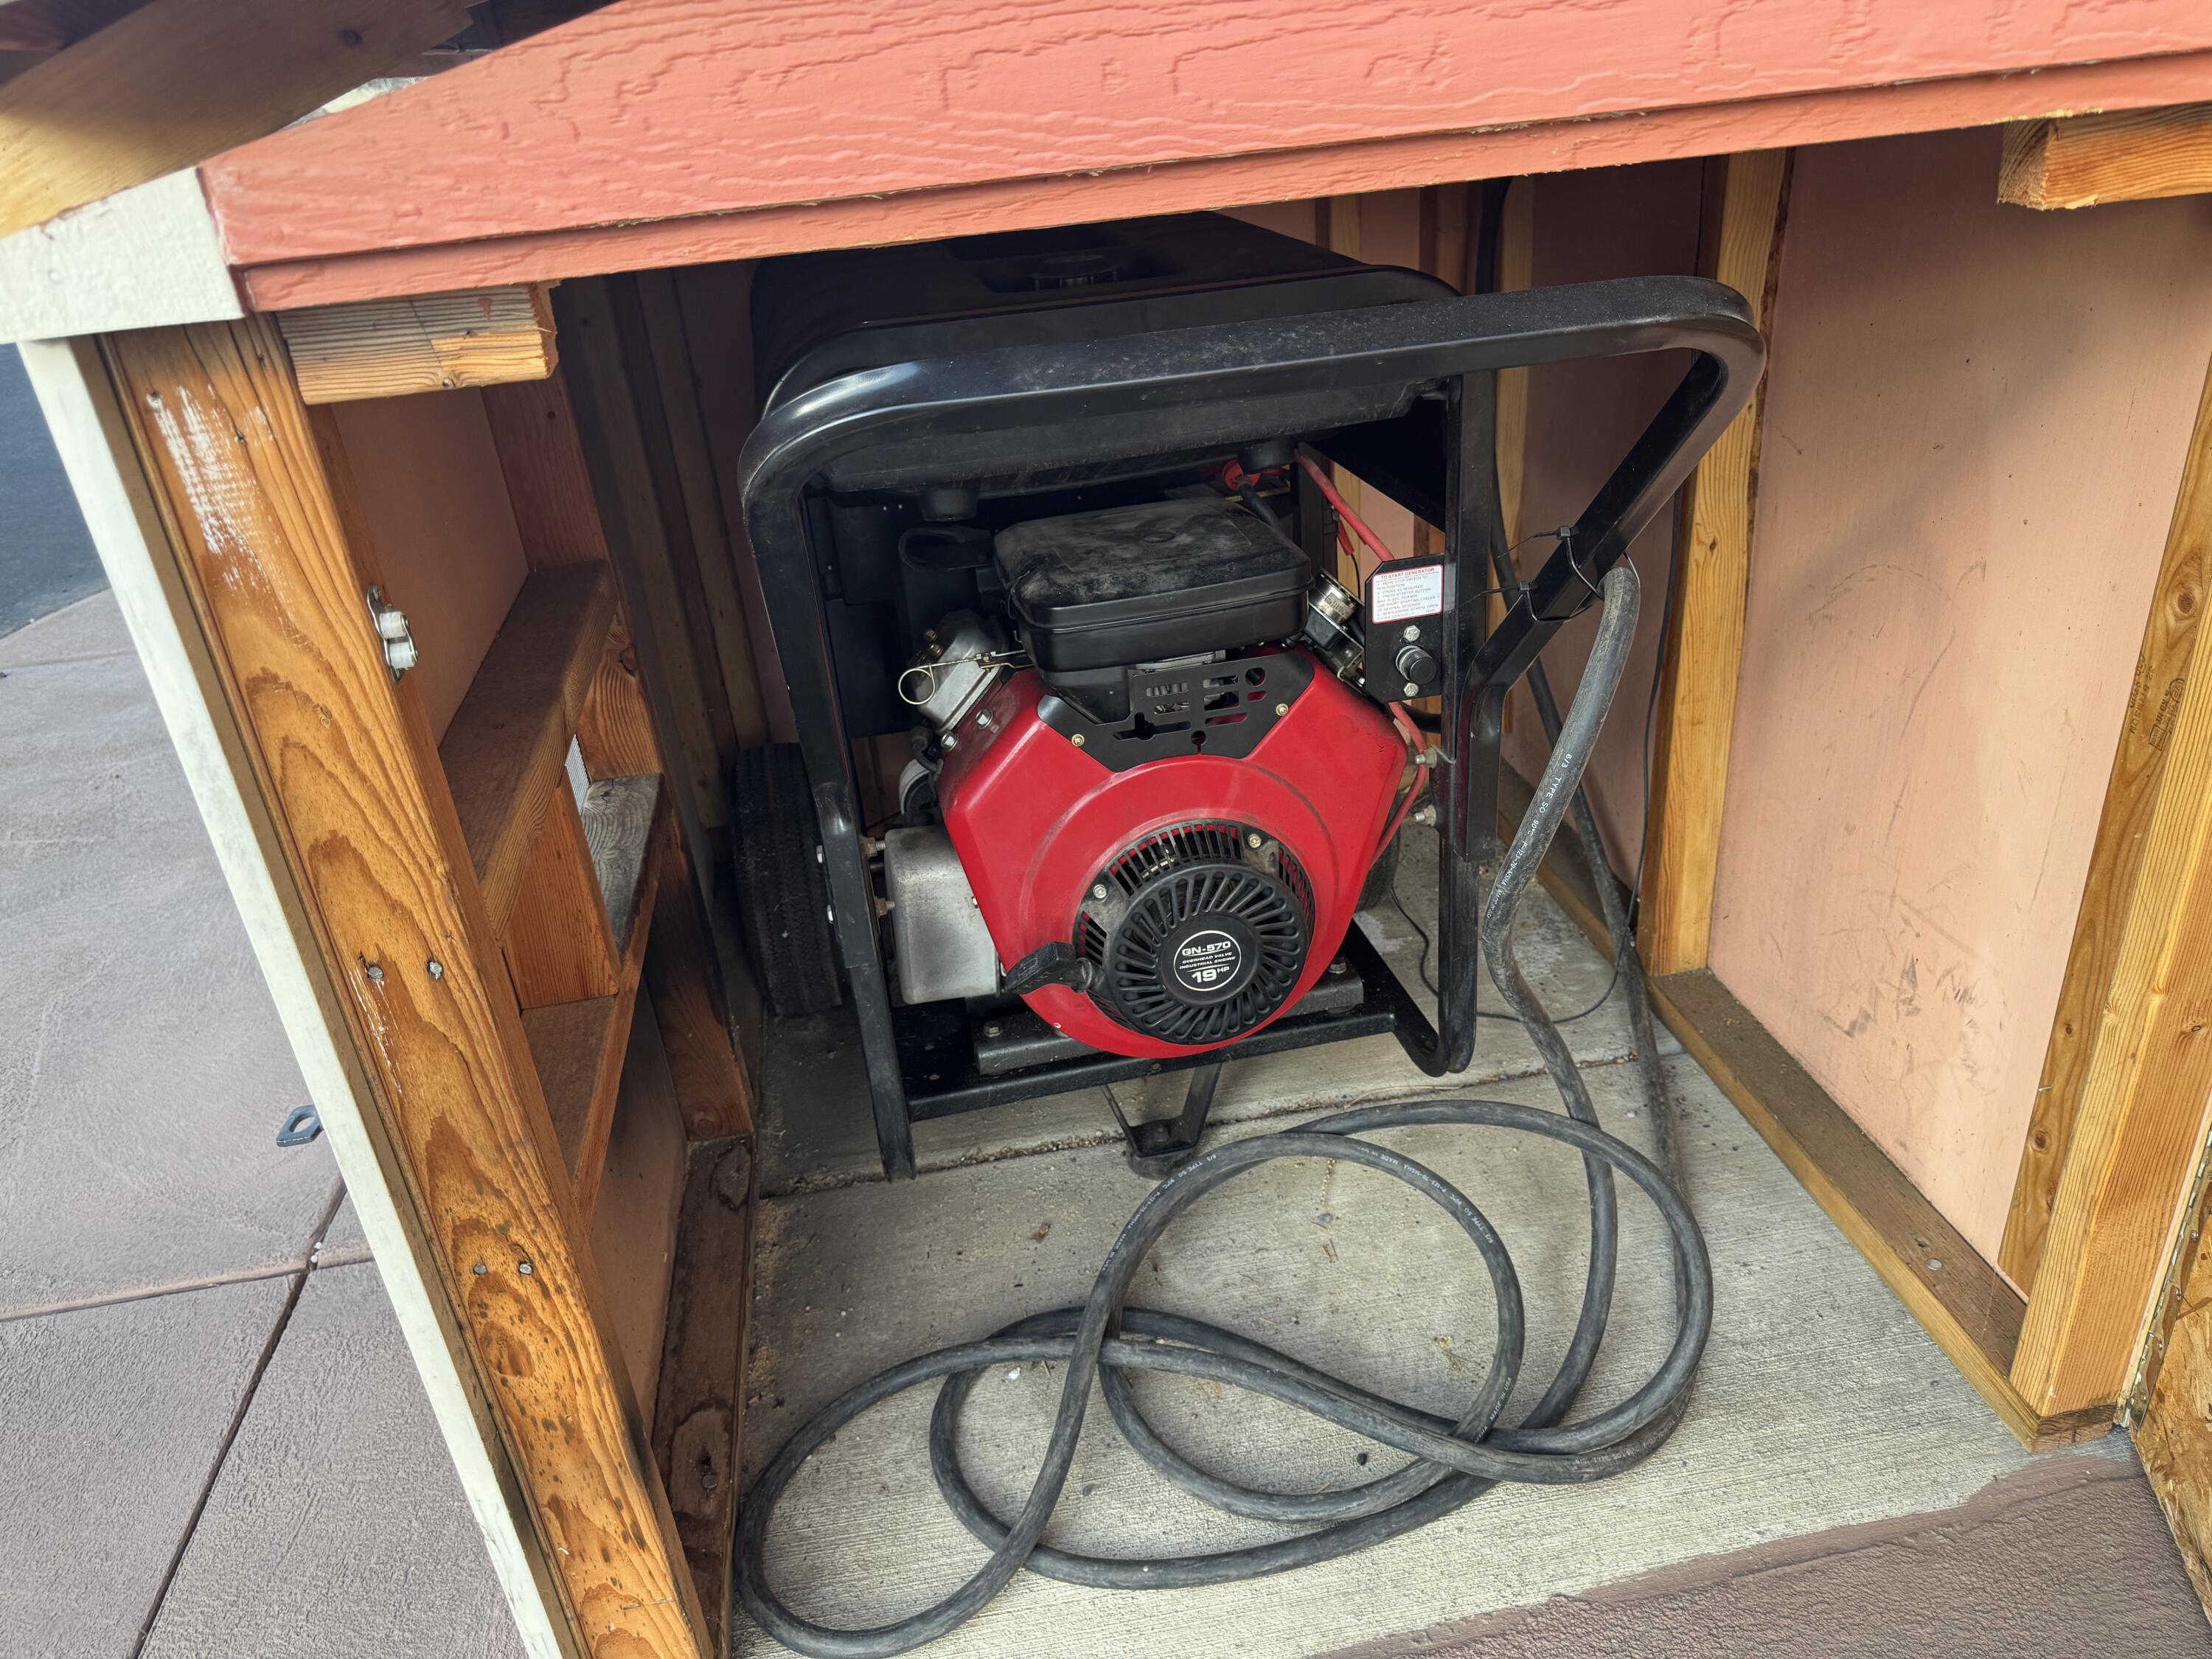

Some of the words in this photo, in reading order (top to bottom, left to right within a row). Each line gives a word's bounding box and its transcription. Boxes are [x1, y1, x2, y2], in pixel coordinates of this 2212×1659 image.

[1562, 754, 1572, 768] 6/3
[1546, 777, 1561, 799] TYPE
[1539, 802, 1548, 813] SO
[1182, 941, 1231, 956] GN-570
[1180, 961, 1213, 969] INDUSTRIAL
[1191, 969, 1217, 983] 19
[1380, 1154, 1398, 1165] MADE
[1464, 1208, 1472, 1216] SO
[1471, 1217, 1485, 1231] TYPE
[1490, 1401, 1501, 1421] MADE
